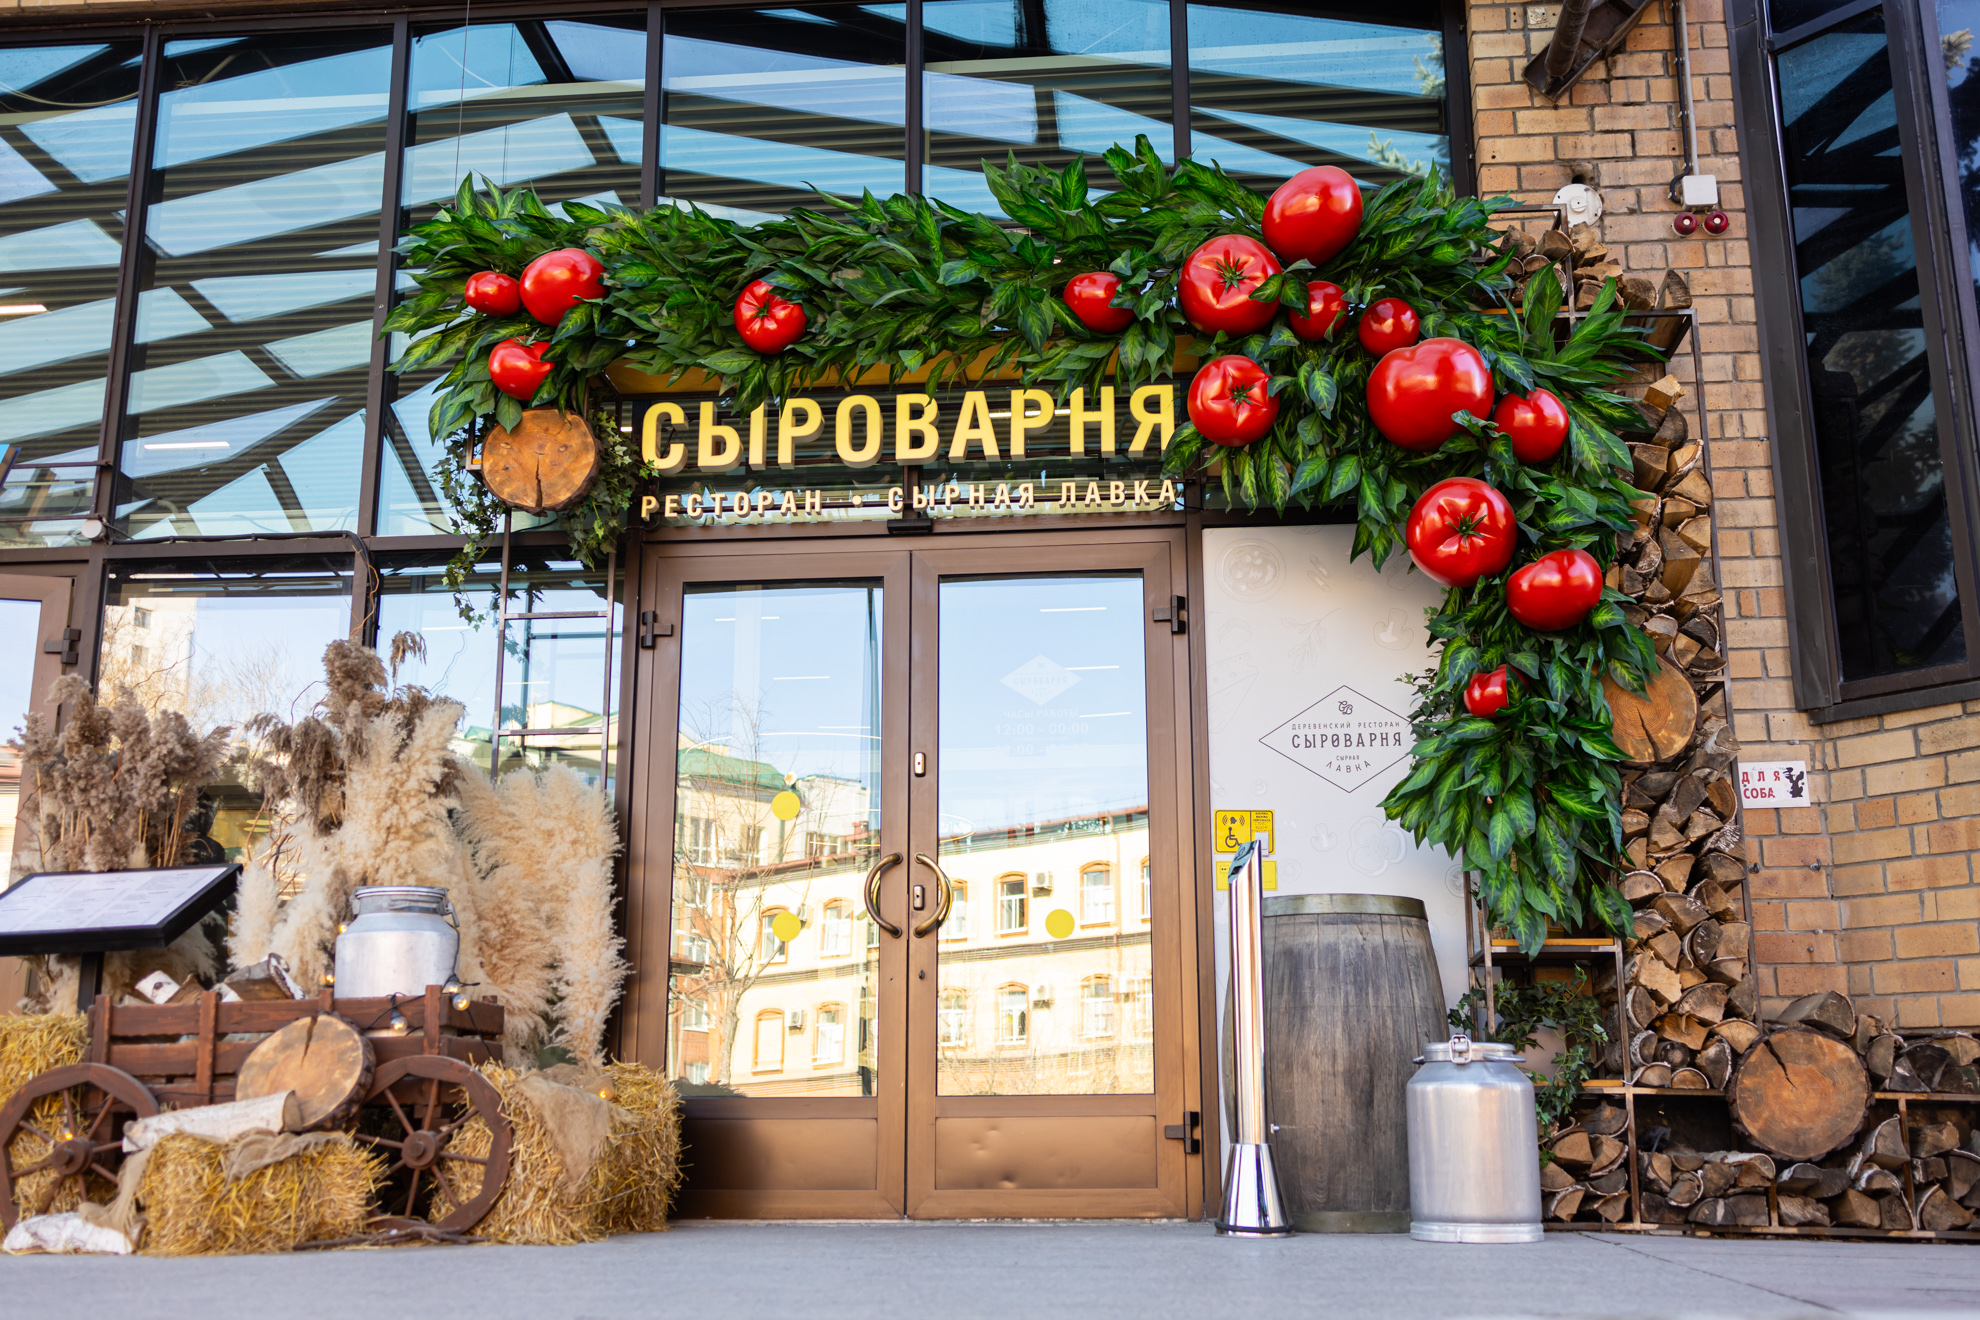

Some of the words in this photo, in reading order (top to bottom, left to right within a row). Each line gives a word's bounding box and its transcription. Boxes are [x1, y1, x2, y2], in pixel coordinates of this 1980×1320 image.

[641, 384, 1176, 474] СЫРОВАРНЯ
[641, 489, 823, 520] РЕСТОРАН
[887, 481, 1035, 513] СЫРНАЯ
[1060, 478, 1177, 508] ЛАВКА
[1003, 709, 1034, 719] ЧАСЫ
[1036, 708, 1079, 719] РАБОТЫ
[994, 723, 1035, 736] 12:00
[1048, 722, 1089, 735] 00:00
[1292, 721, 1351, 730] ДЕРЕВЕНСКИЙ
[1358, 721, 1400, 729] РЕСТОРАН
[1292, 732, 1402, 748] СЫРОВАРНЯ
[1325, 760, 1372, 774] ЛАВКА
[1742, 771, 1781, 784] ДЛЯ
[1743, 787, 1776, 799] СОБА
